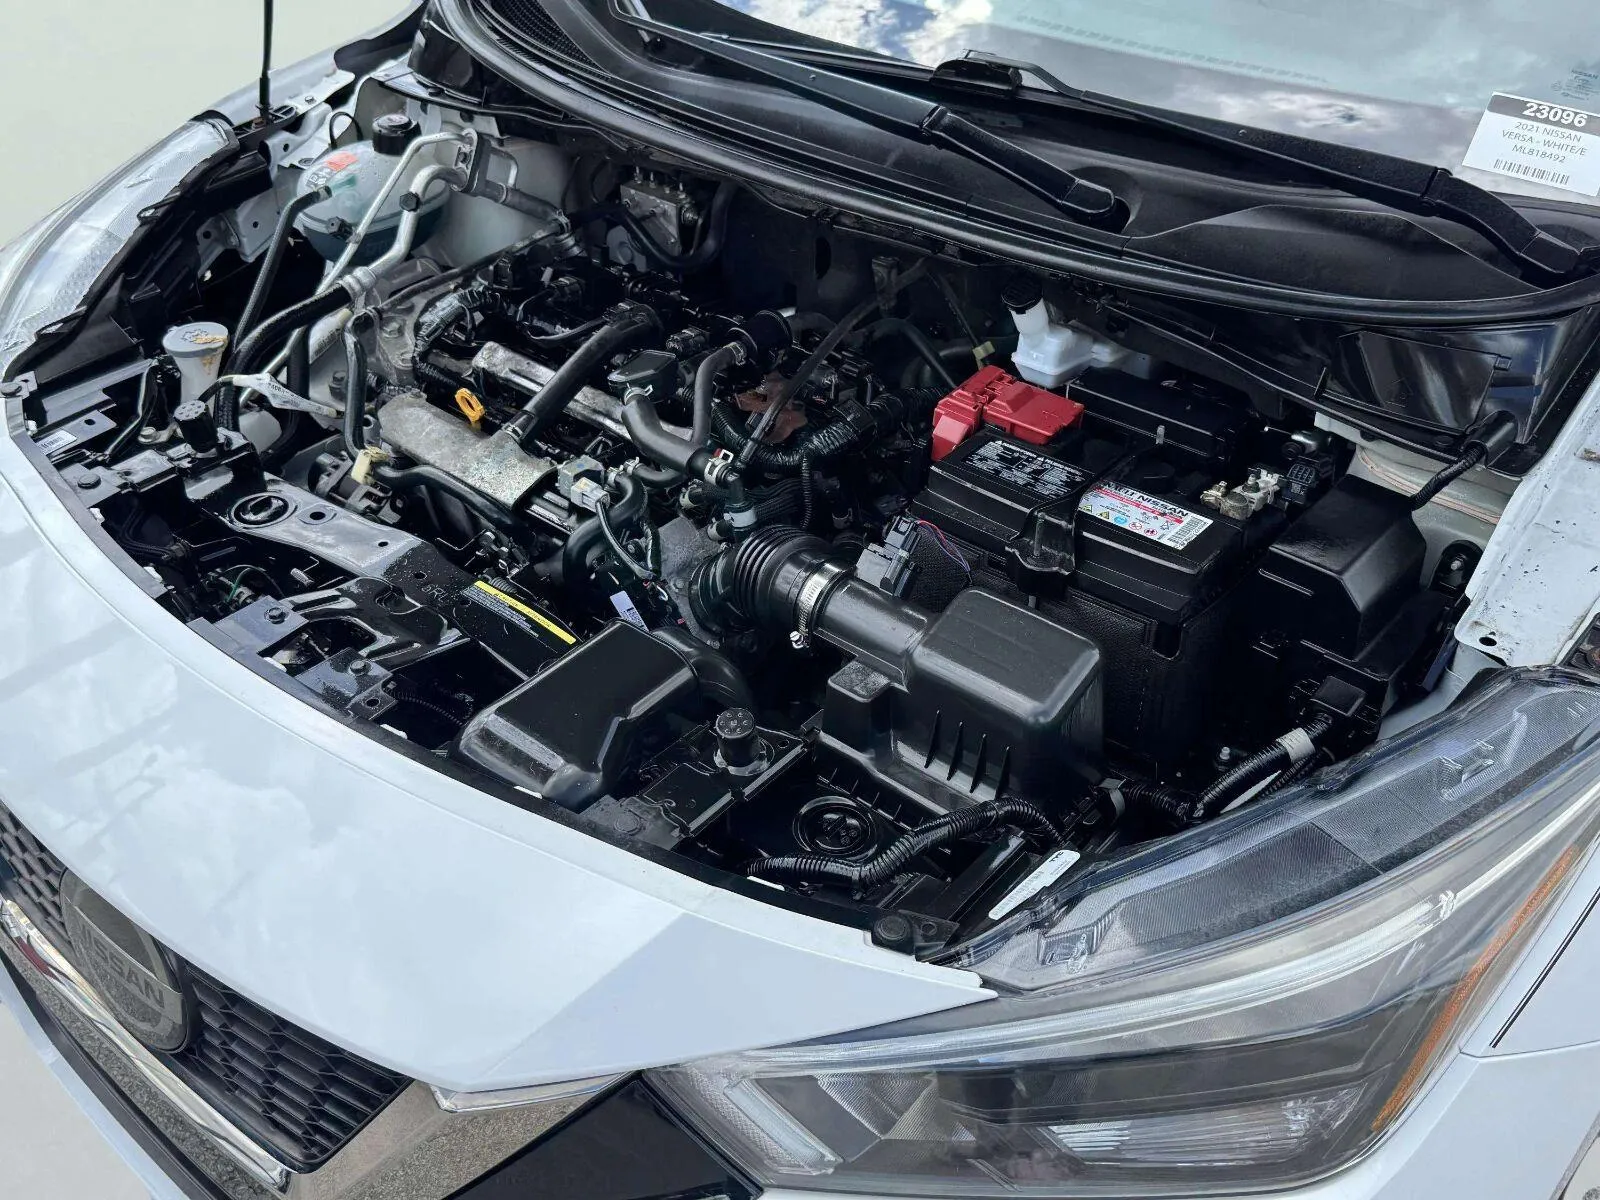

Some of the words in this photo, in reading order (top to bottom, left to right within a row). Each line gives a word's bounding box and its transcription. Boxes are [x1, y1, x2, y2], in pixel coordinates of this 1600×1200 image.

[1522, 102, 1588, 127] 23096
[1502, 130, 1534, 144] VERSA
[1543, 139, 1588, 157] WHITE/E
[1515, 121, 1539, 134] 2021
[1542, 127, 1582, 143] NISSAN
[1511, 144, 1566, 164] ML818492
[1137, 493, 1189, 517] NISSAN
[77, 919, 167, 1010] NISSAN
